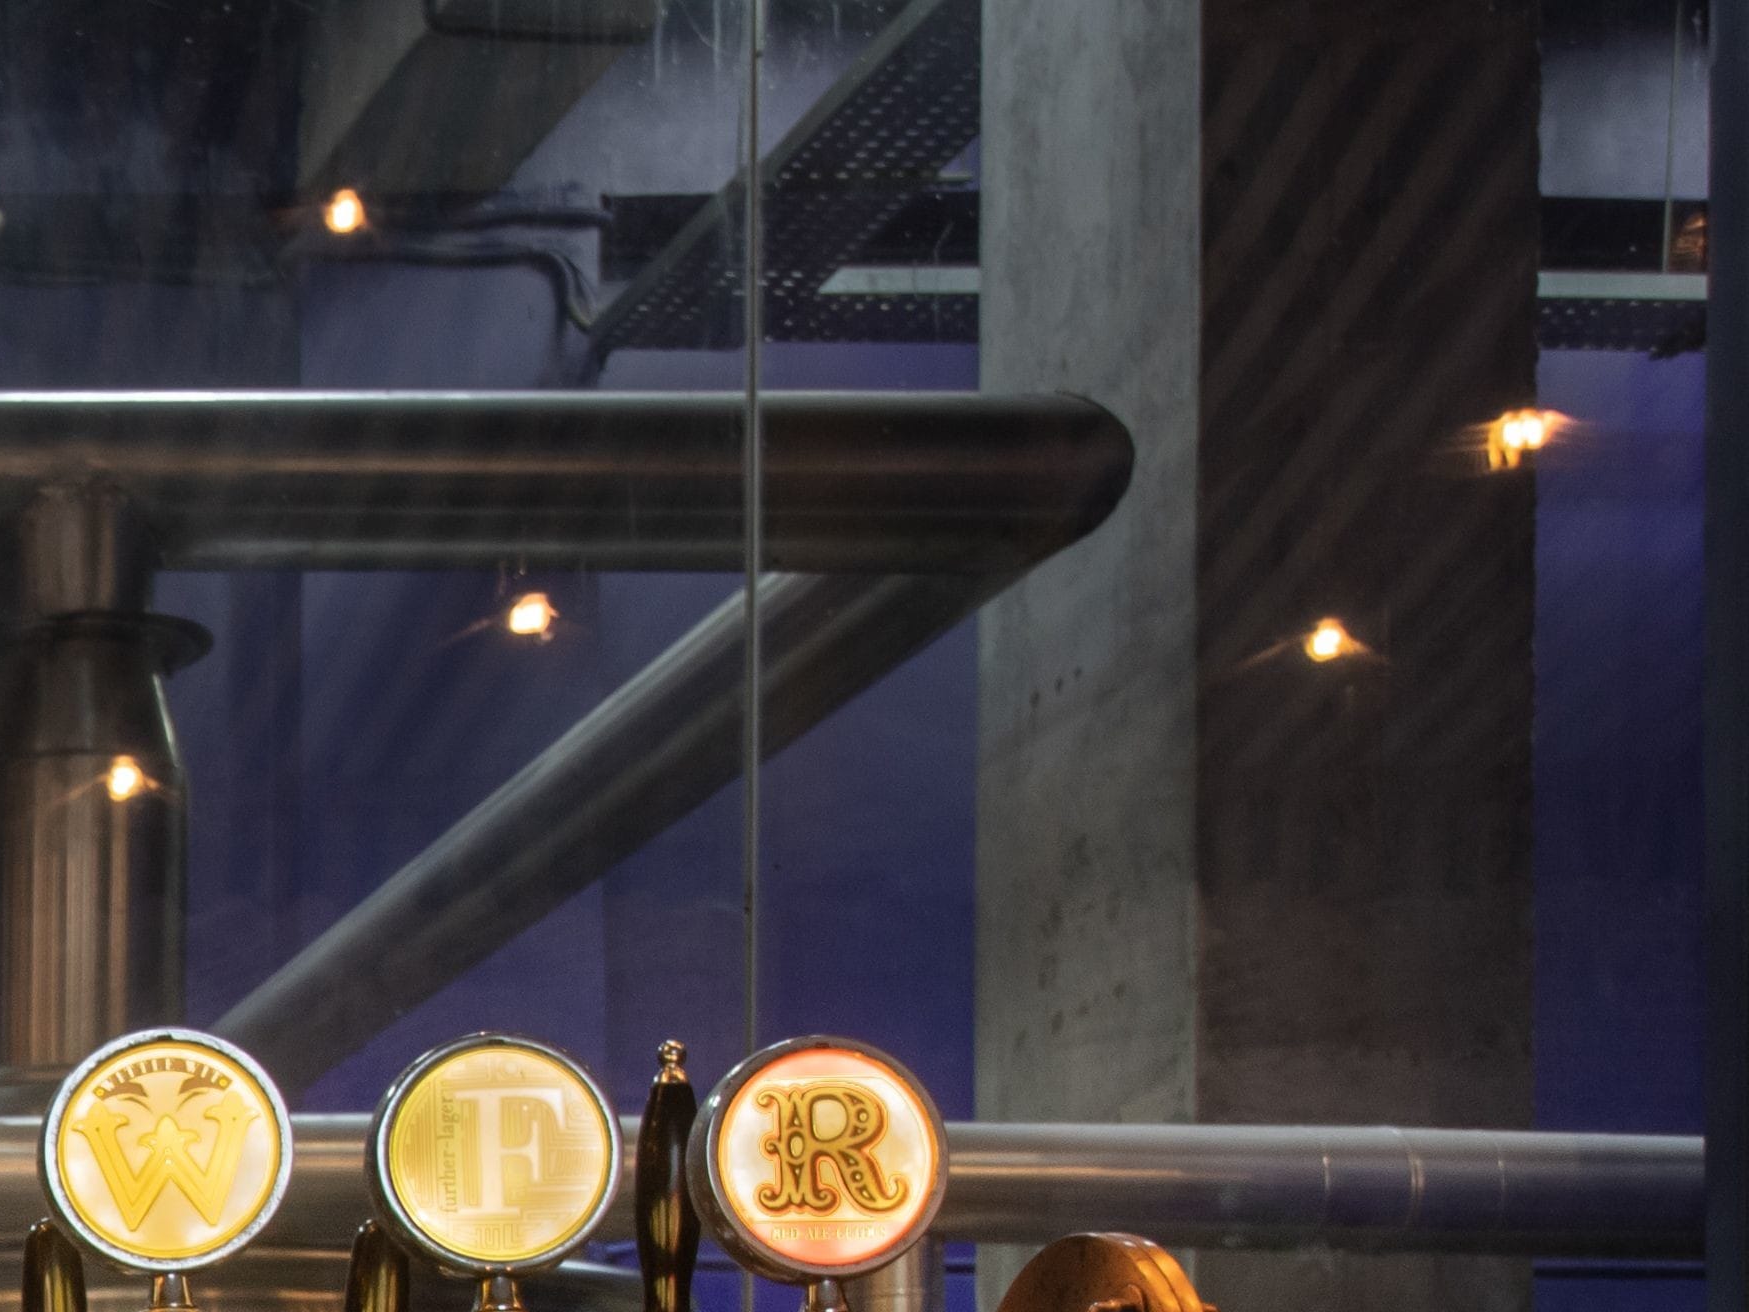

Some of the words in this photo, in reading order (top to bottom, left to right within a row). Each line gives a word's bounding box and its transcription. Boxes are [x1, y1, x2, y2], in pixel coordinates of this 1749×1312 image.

[72, 1091, 260, 1232] W
[454, 1087, 566, 1216] F
[757, 1086, 910, 1213] R
